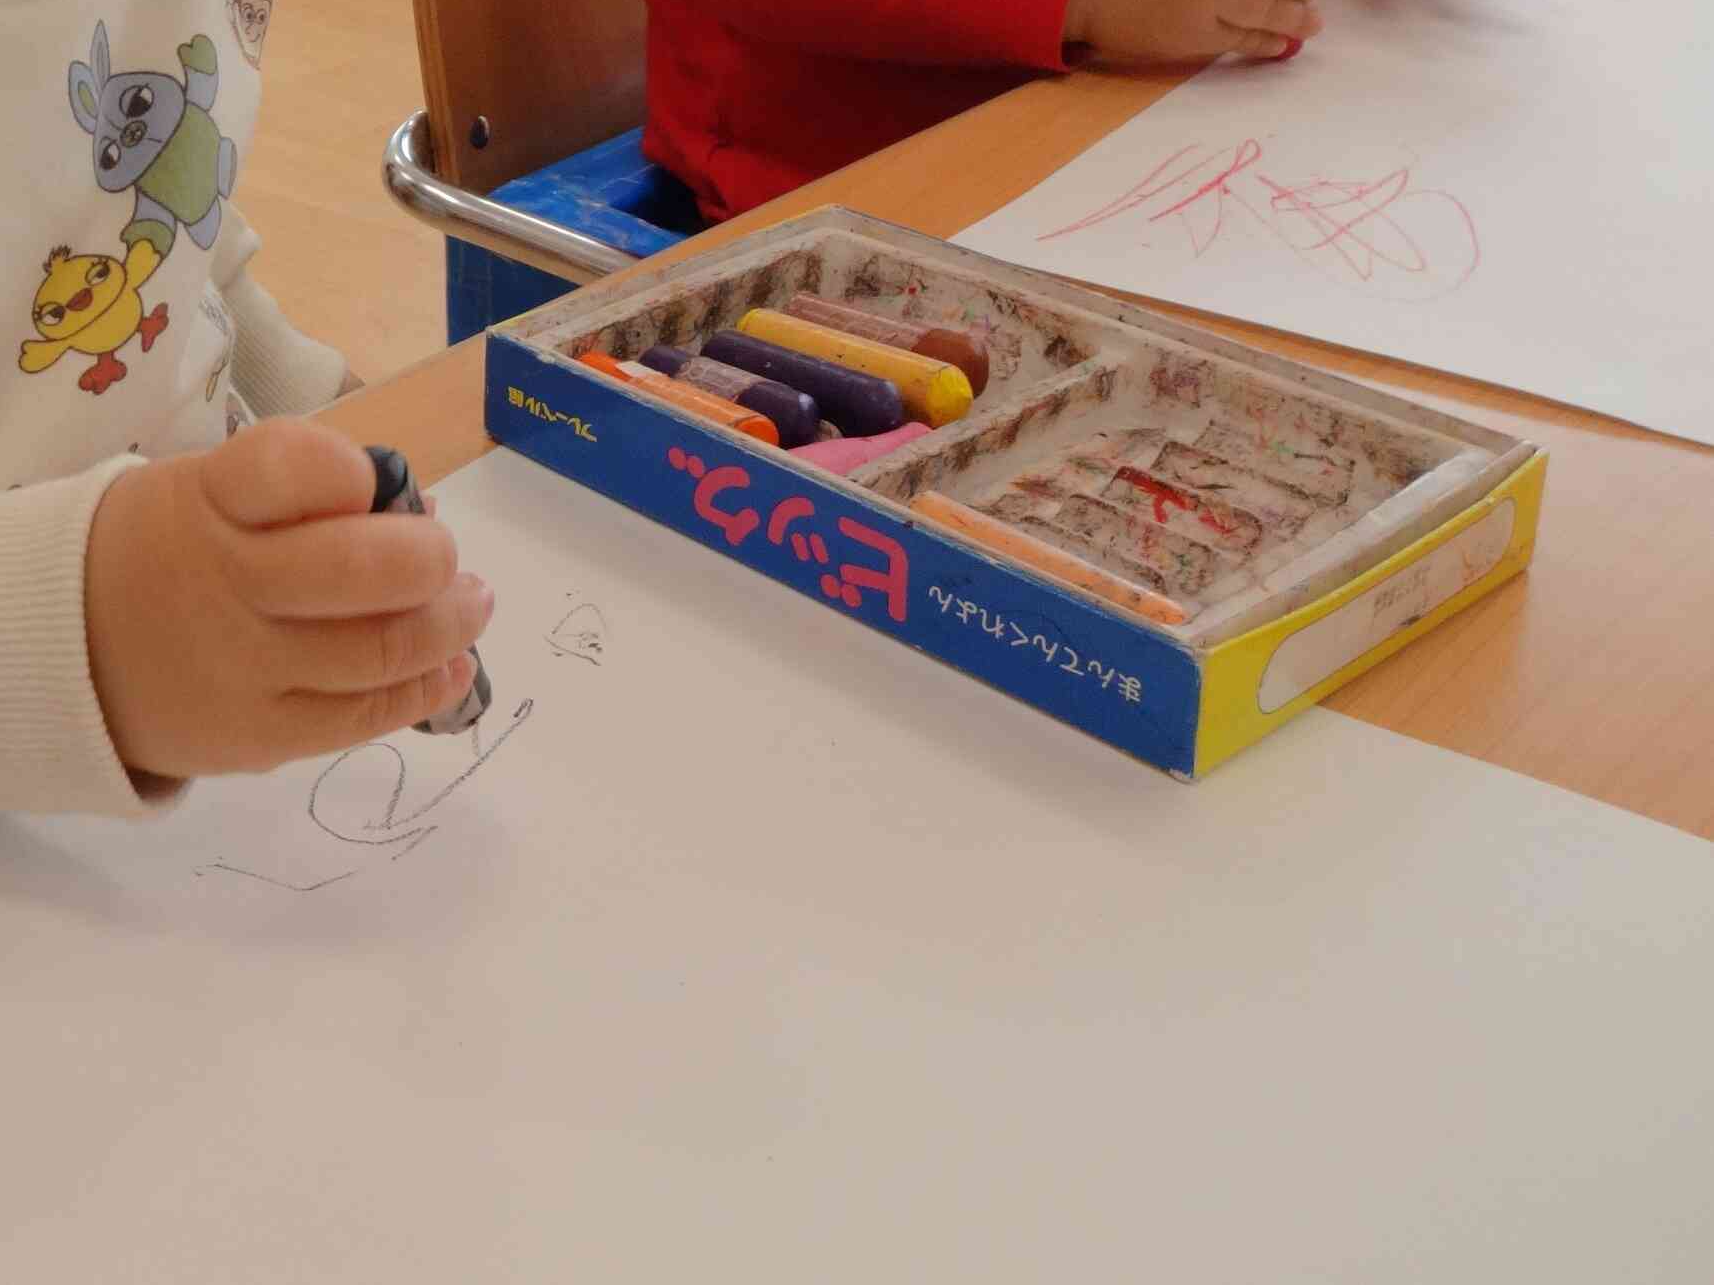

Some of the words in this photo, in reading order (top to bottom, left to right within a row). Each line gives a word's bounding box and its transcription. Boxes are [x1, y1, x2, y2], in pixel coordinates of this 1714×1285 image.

[667, 446, 909, 623] ビッグ
[928, 585, 1143, 702] まんてんくれよん
